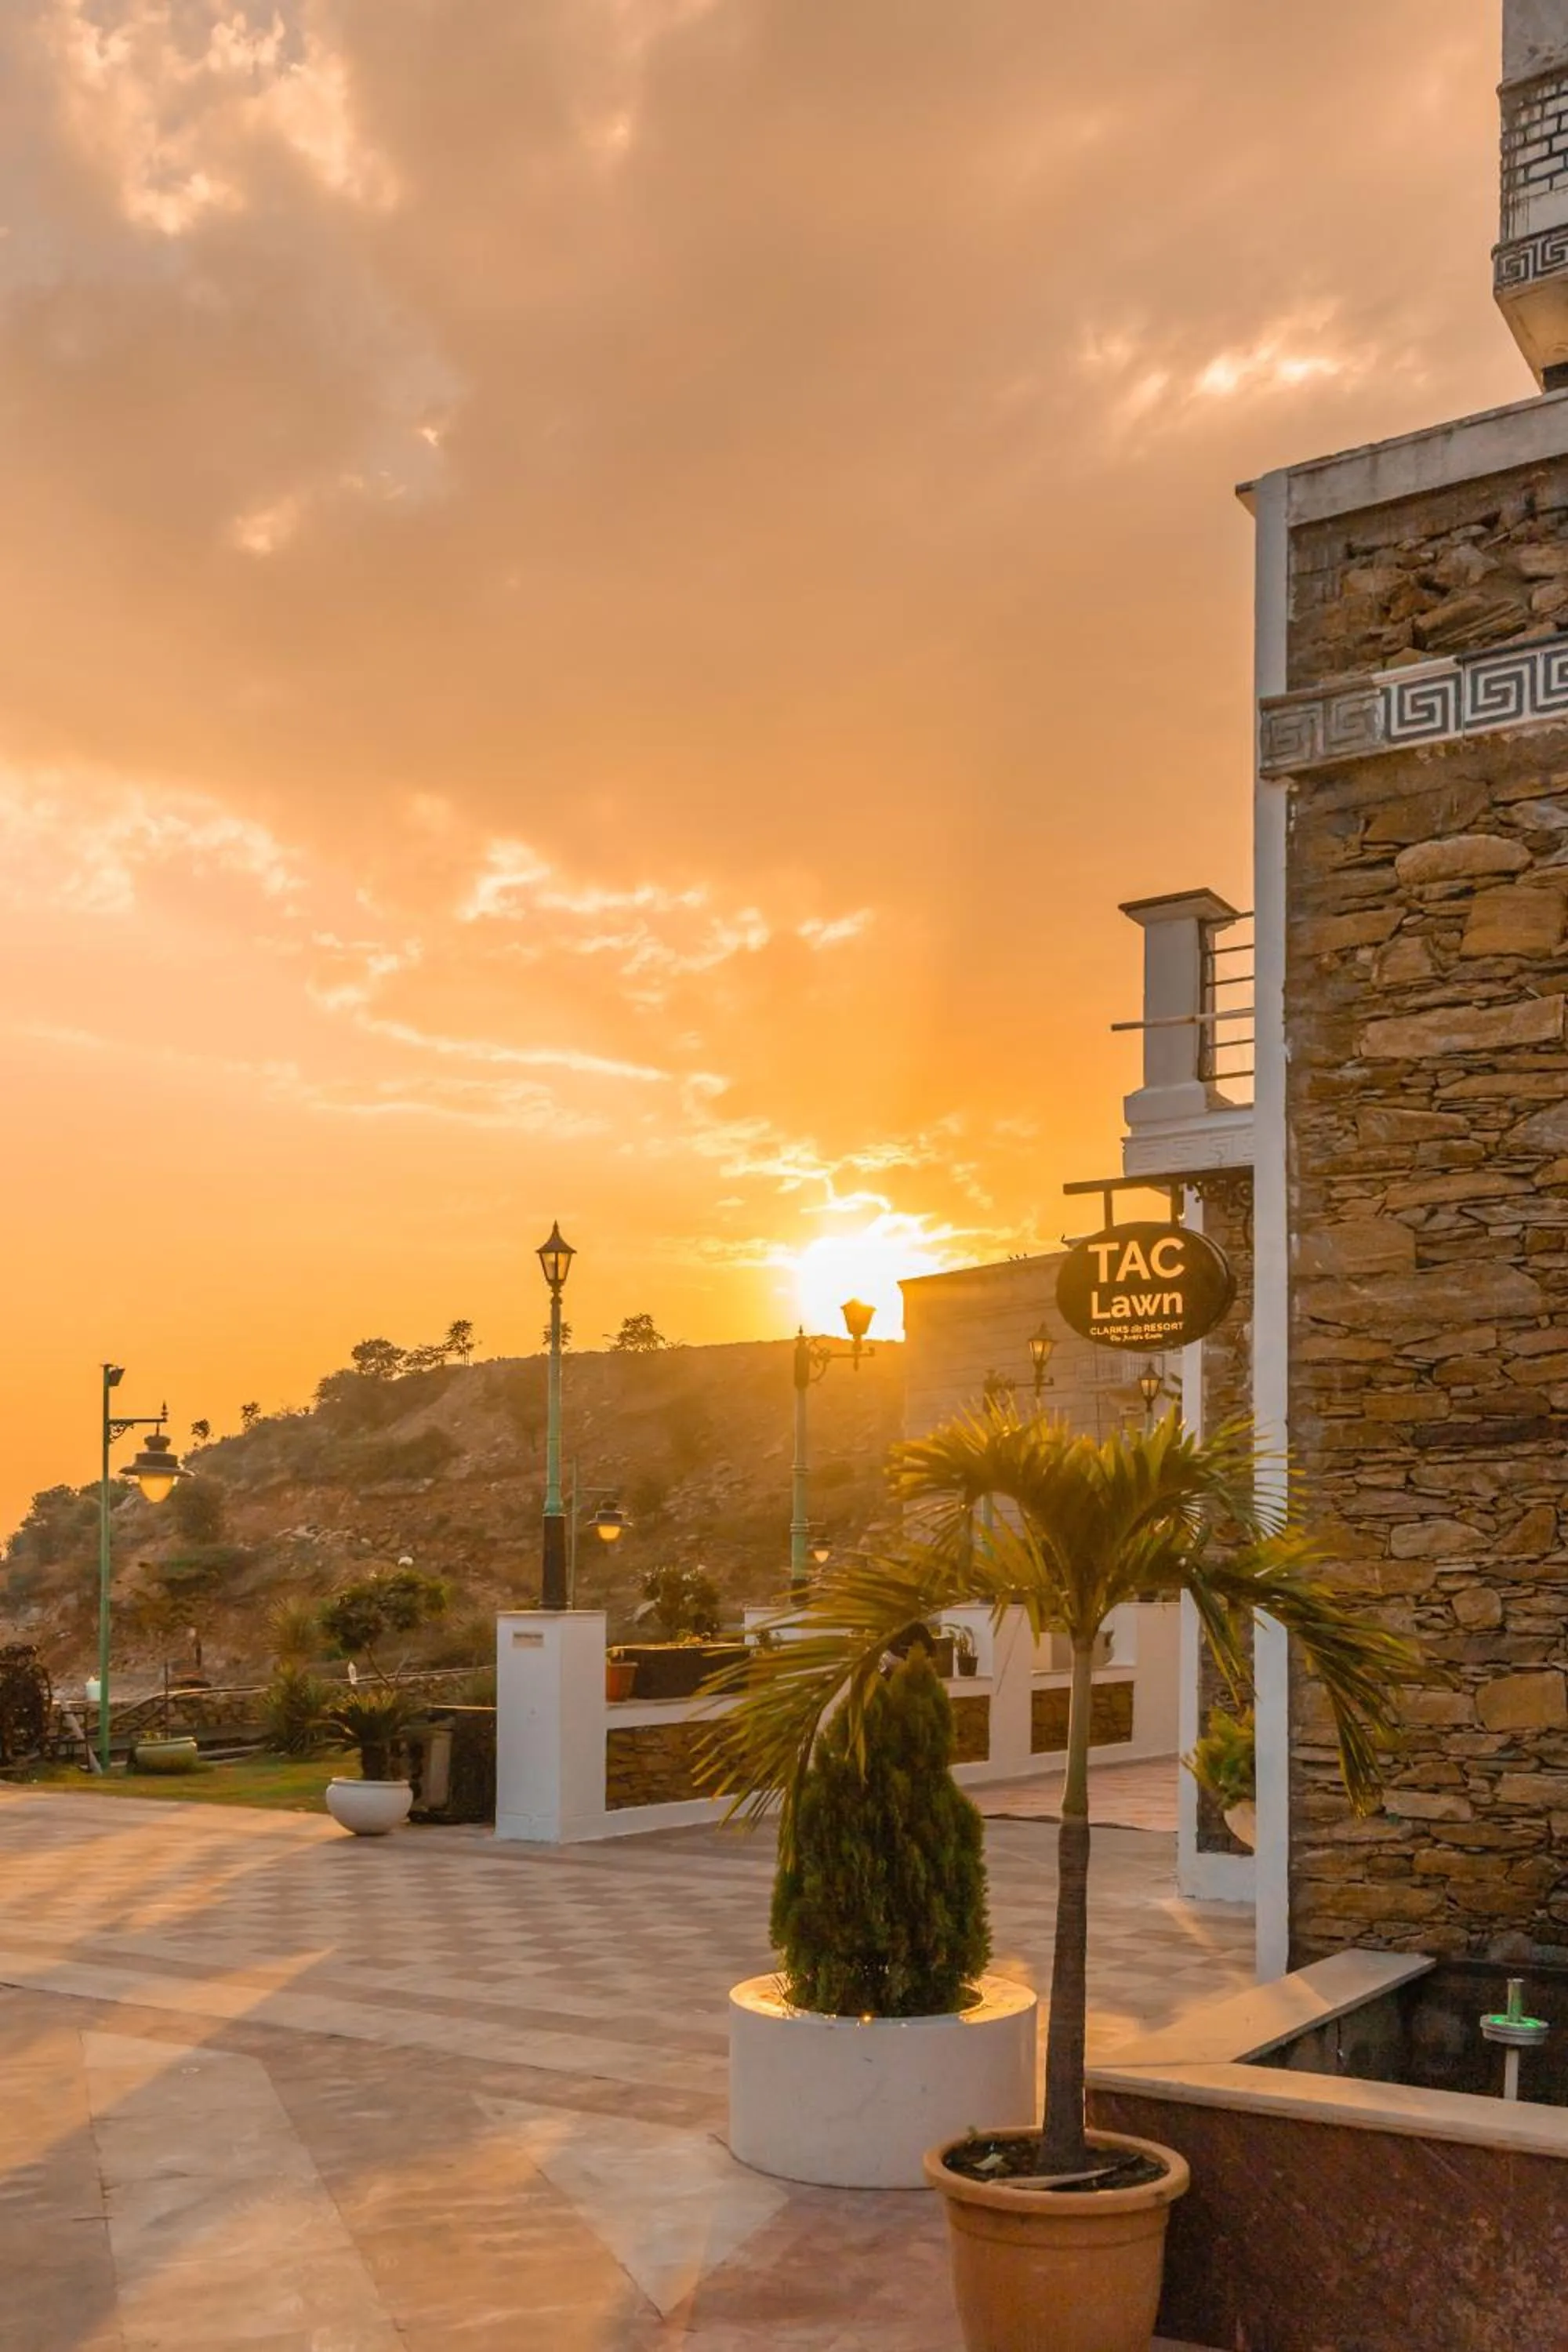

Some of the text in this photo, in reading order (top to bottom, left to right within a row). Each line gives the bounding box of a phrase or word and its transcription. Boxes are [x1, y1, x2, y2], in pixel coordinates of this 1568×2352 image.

[1088, 1238, 1185, 1283] TAC
[1091, 1291, 1183, 1319] Lawn
[1090, 1322, 1184, 1336] CLARKS RESORT
